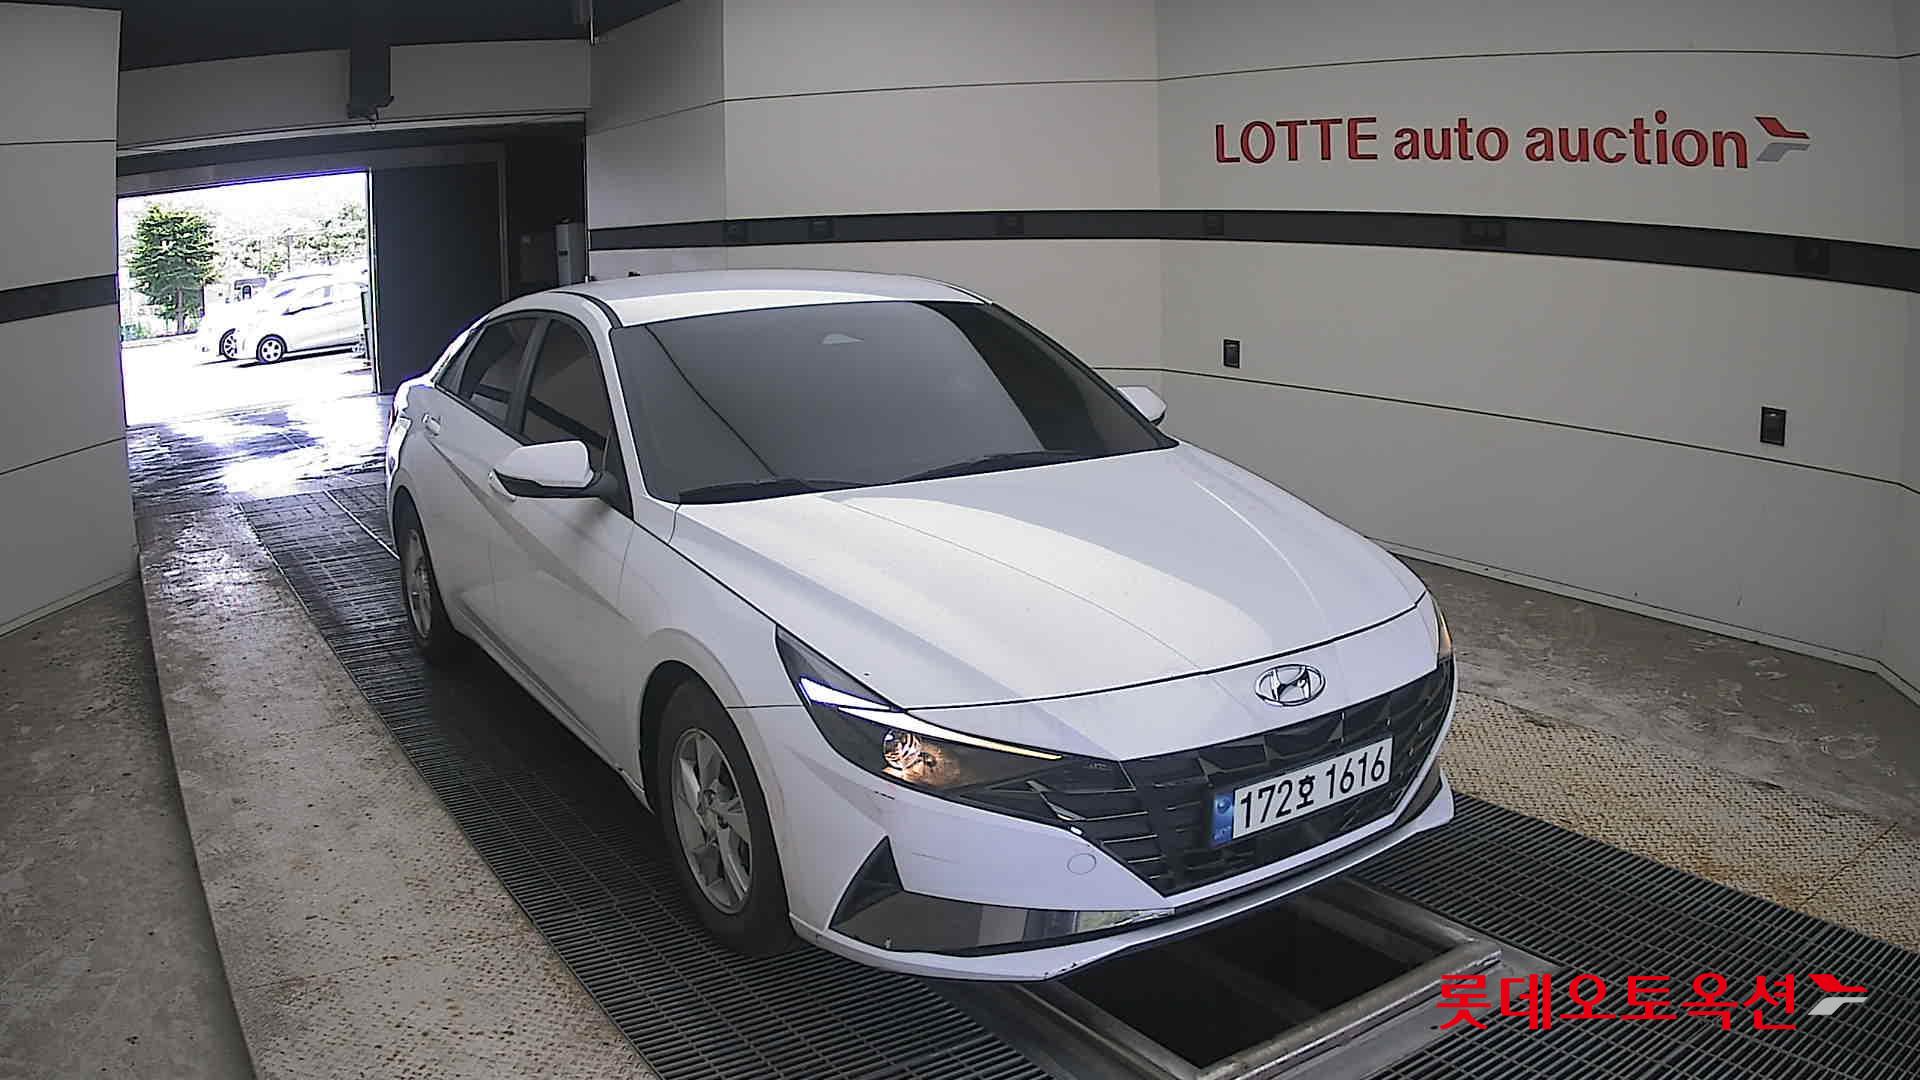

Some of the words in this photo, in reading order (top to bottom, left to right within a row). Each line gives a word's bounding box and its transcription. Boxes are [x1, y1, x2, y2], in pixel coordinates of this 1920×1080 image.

[1215, 117, 1378, 164] LOTTE
[1394, 117, 1508, 162] auto
[1525, 110, 1749, 169] auction
[1240, 774, 1316, 828] 172호
[1326, 746, 1386, 799] 1616
